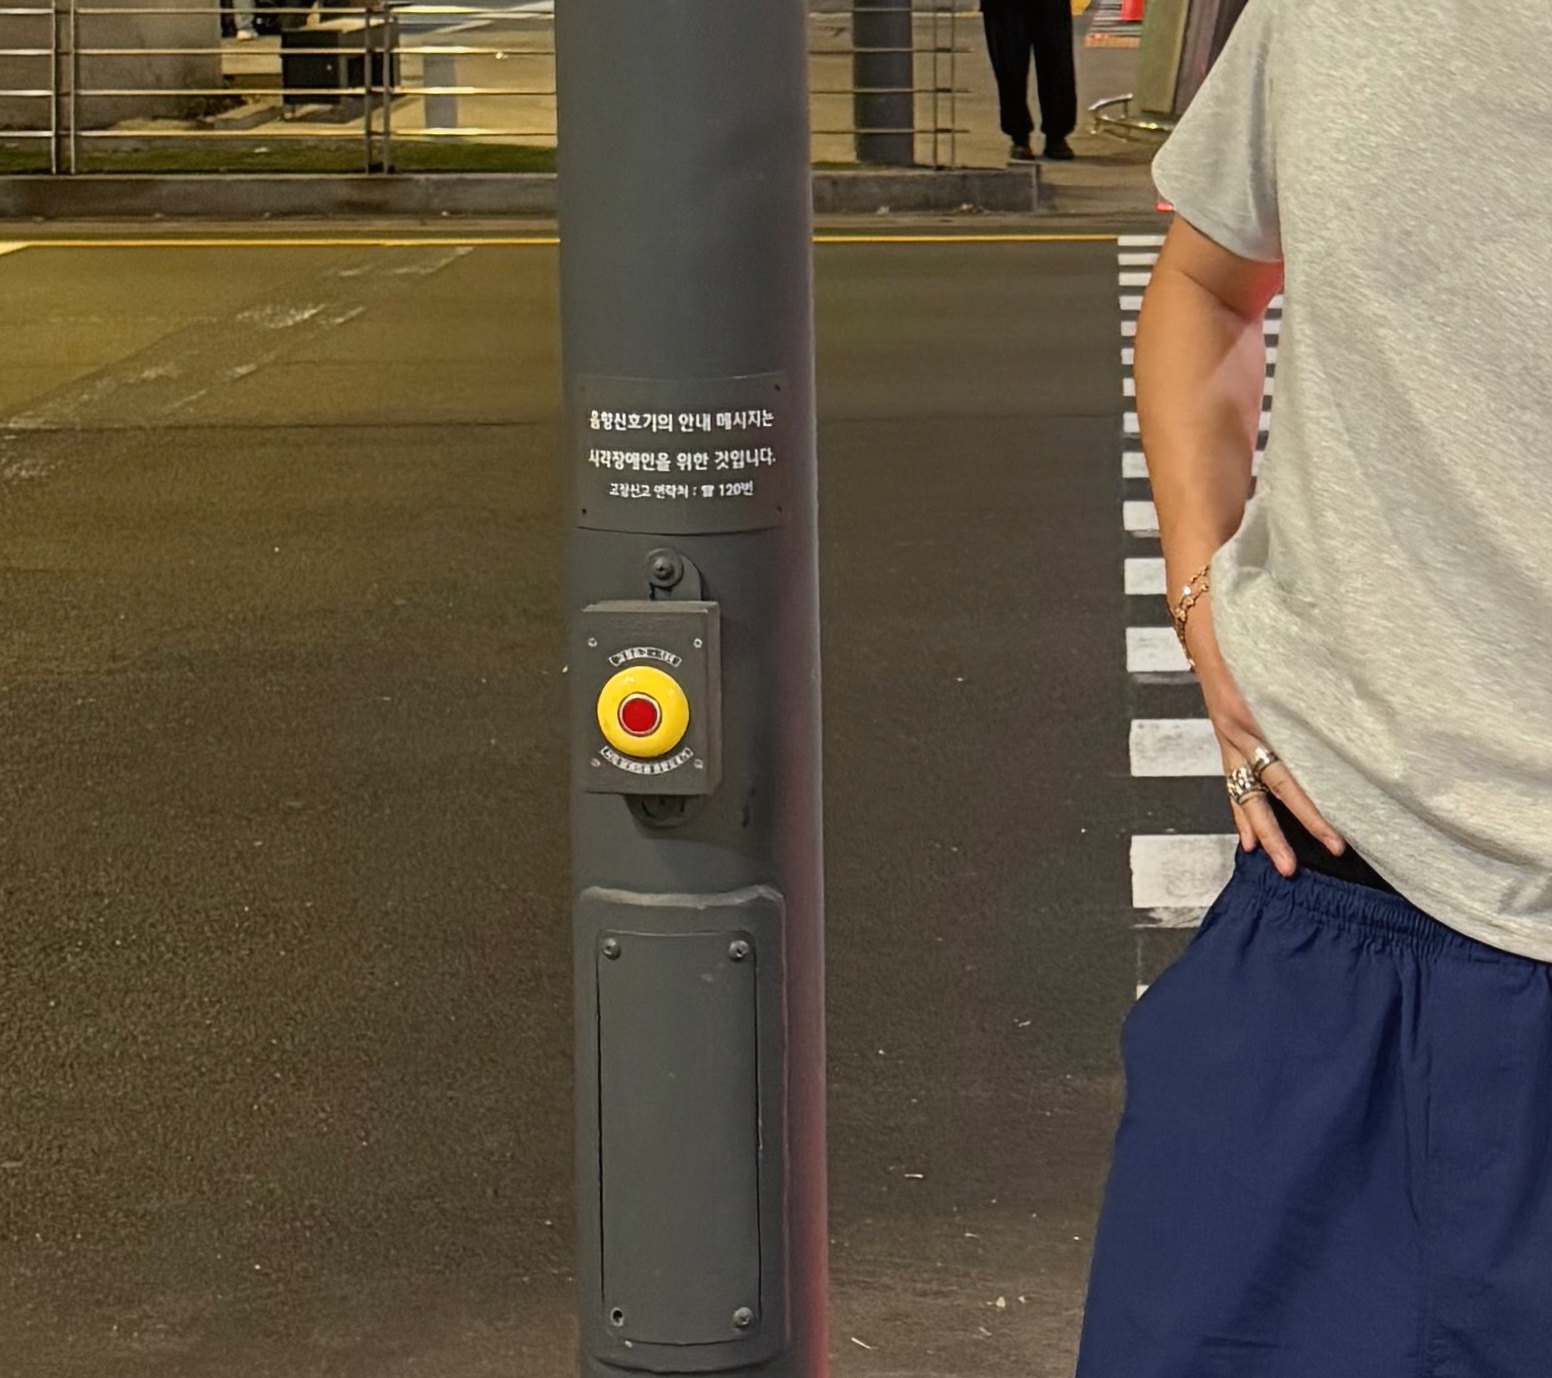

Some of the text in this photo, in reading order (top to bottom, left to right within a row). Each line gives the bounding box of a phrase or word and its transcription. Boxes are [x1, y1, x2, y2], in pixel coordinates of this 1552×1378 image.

[590, 409, 774, 432] 음향신호기의 안내 메시지는
[588, 447, 776, 471] 시각장애인을 위한 것입니다.
